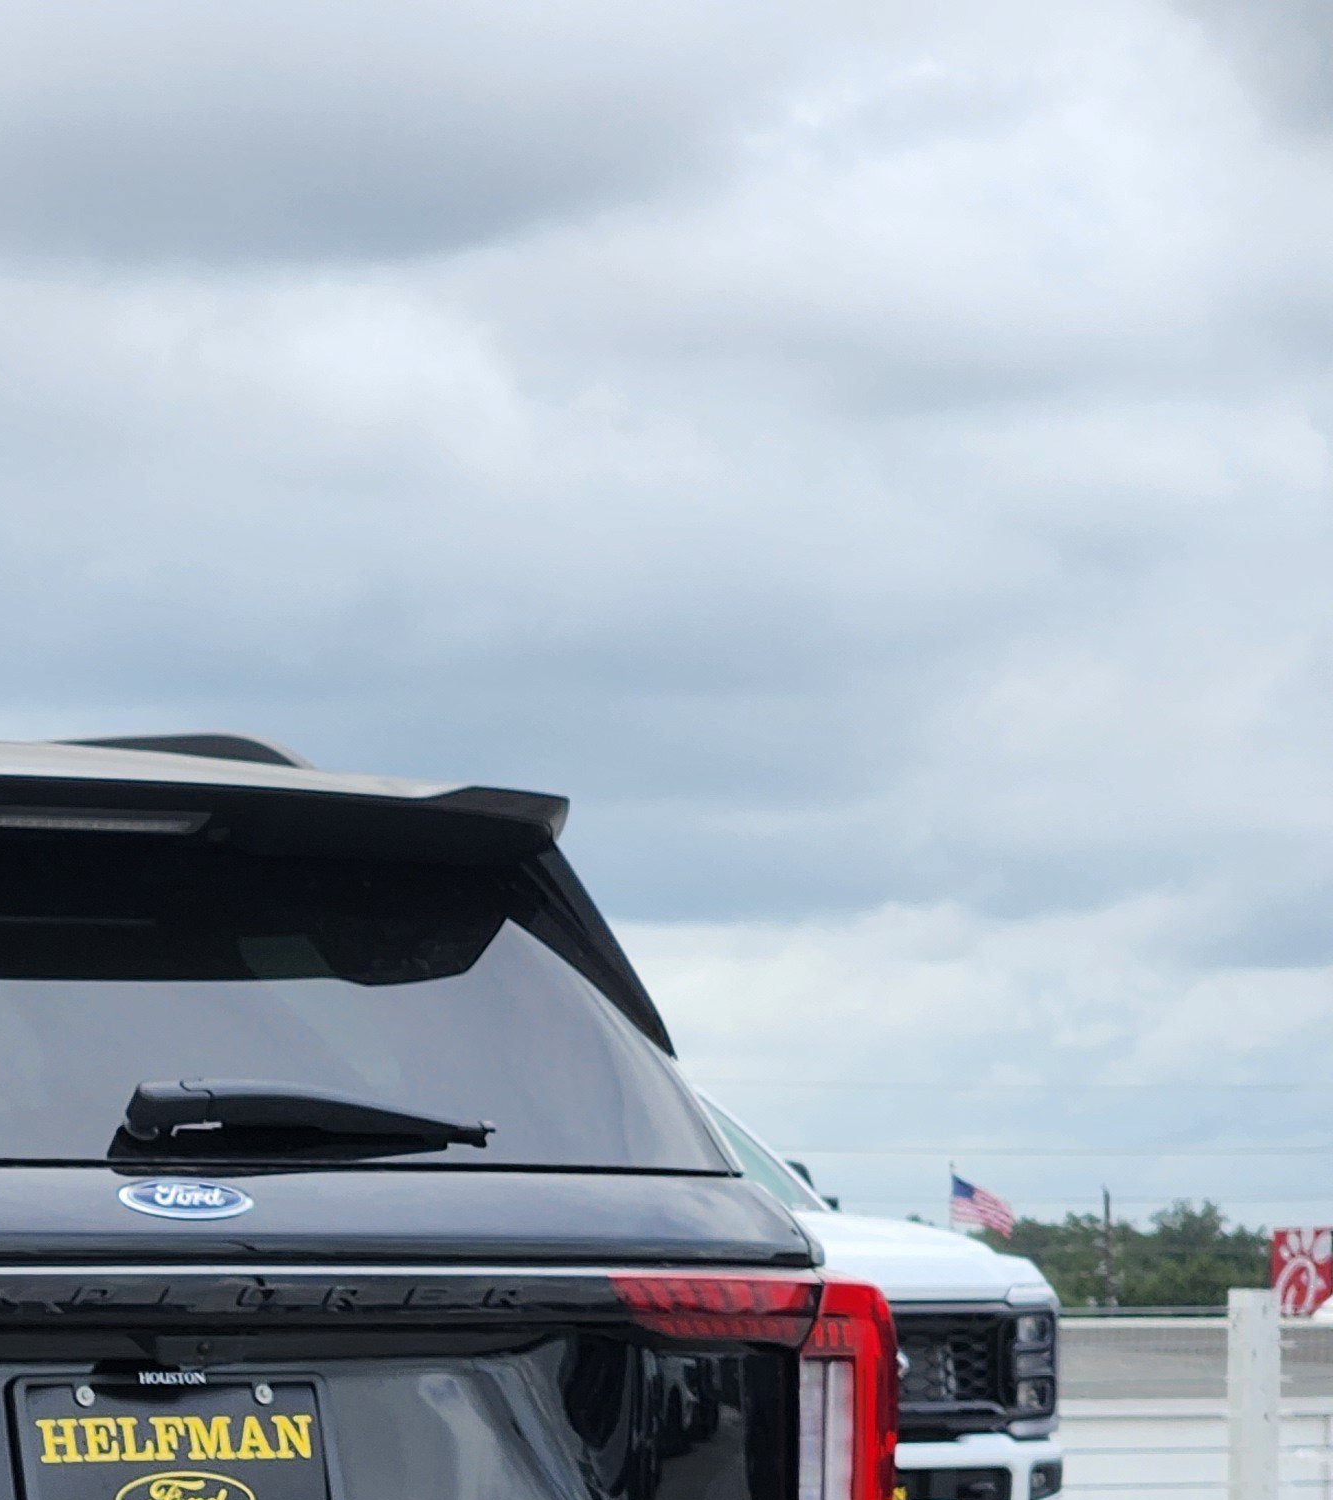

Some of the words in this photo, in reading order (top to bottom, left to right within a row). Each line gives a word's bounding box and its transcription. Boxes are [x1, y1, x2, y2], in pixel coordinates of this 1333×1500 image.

[153, 1183, 226, 1206] Ford
[139, 1371, 206, 1385] HOUSTON
[36, 1414, 312, 1463] HELFMAN
